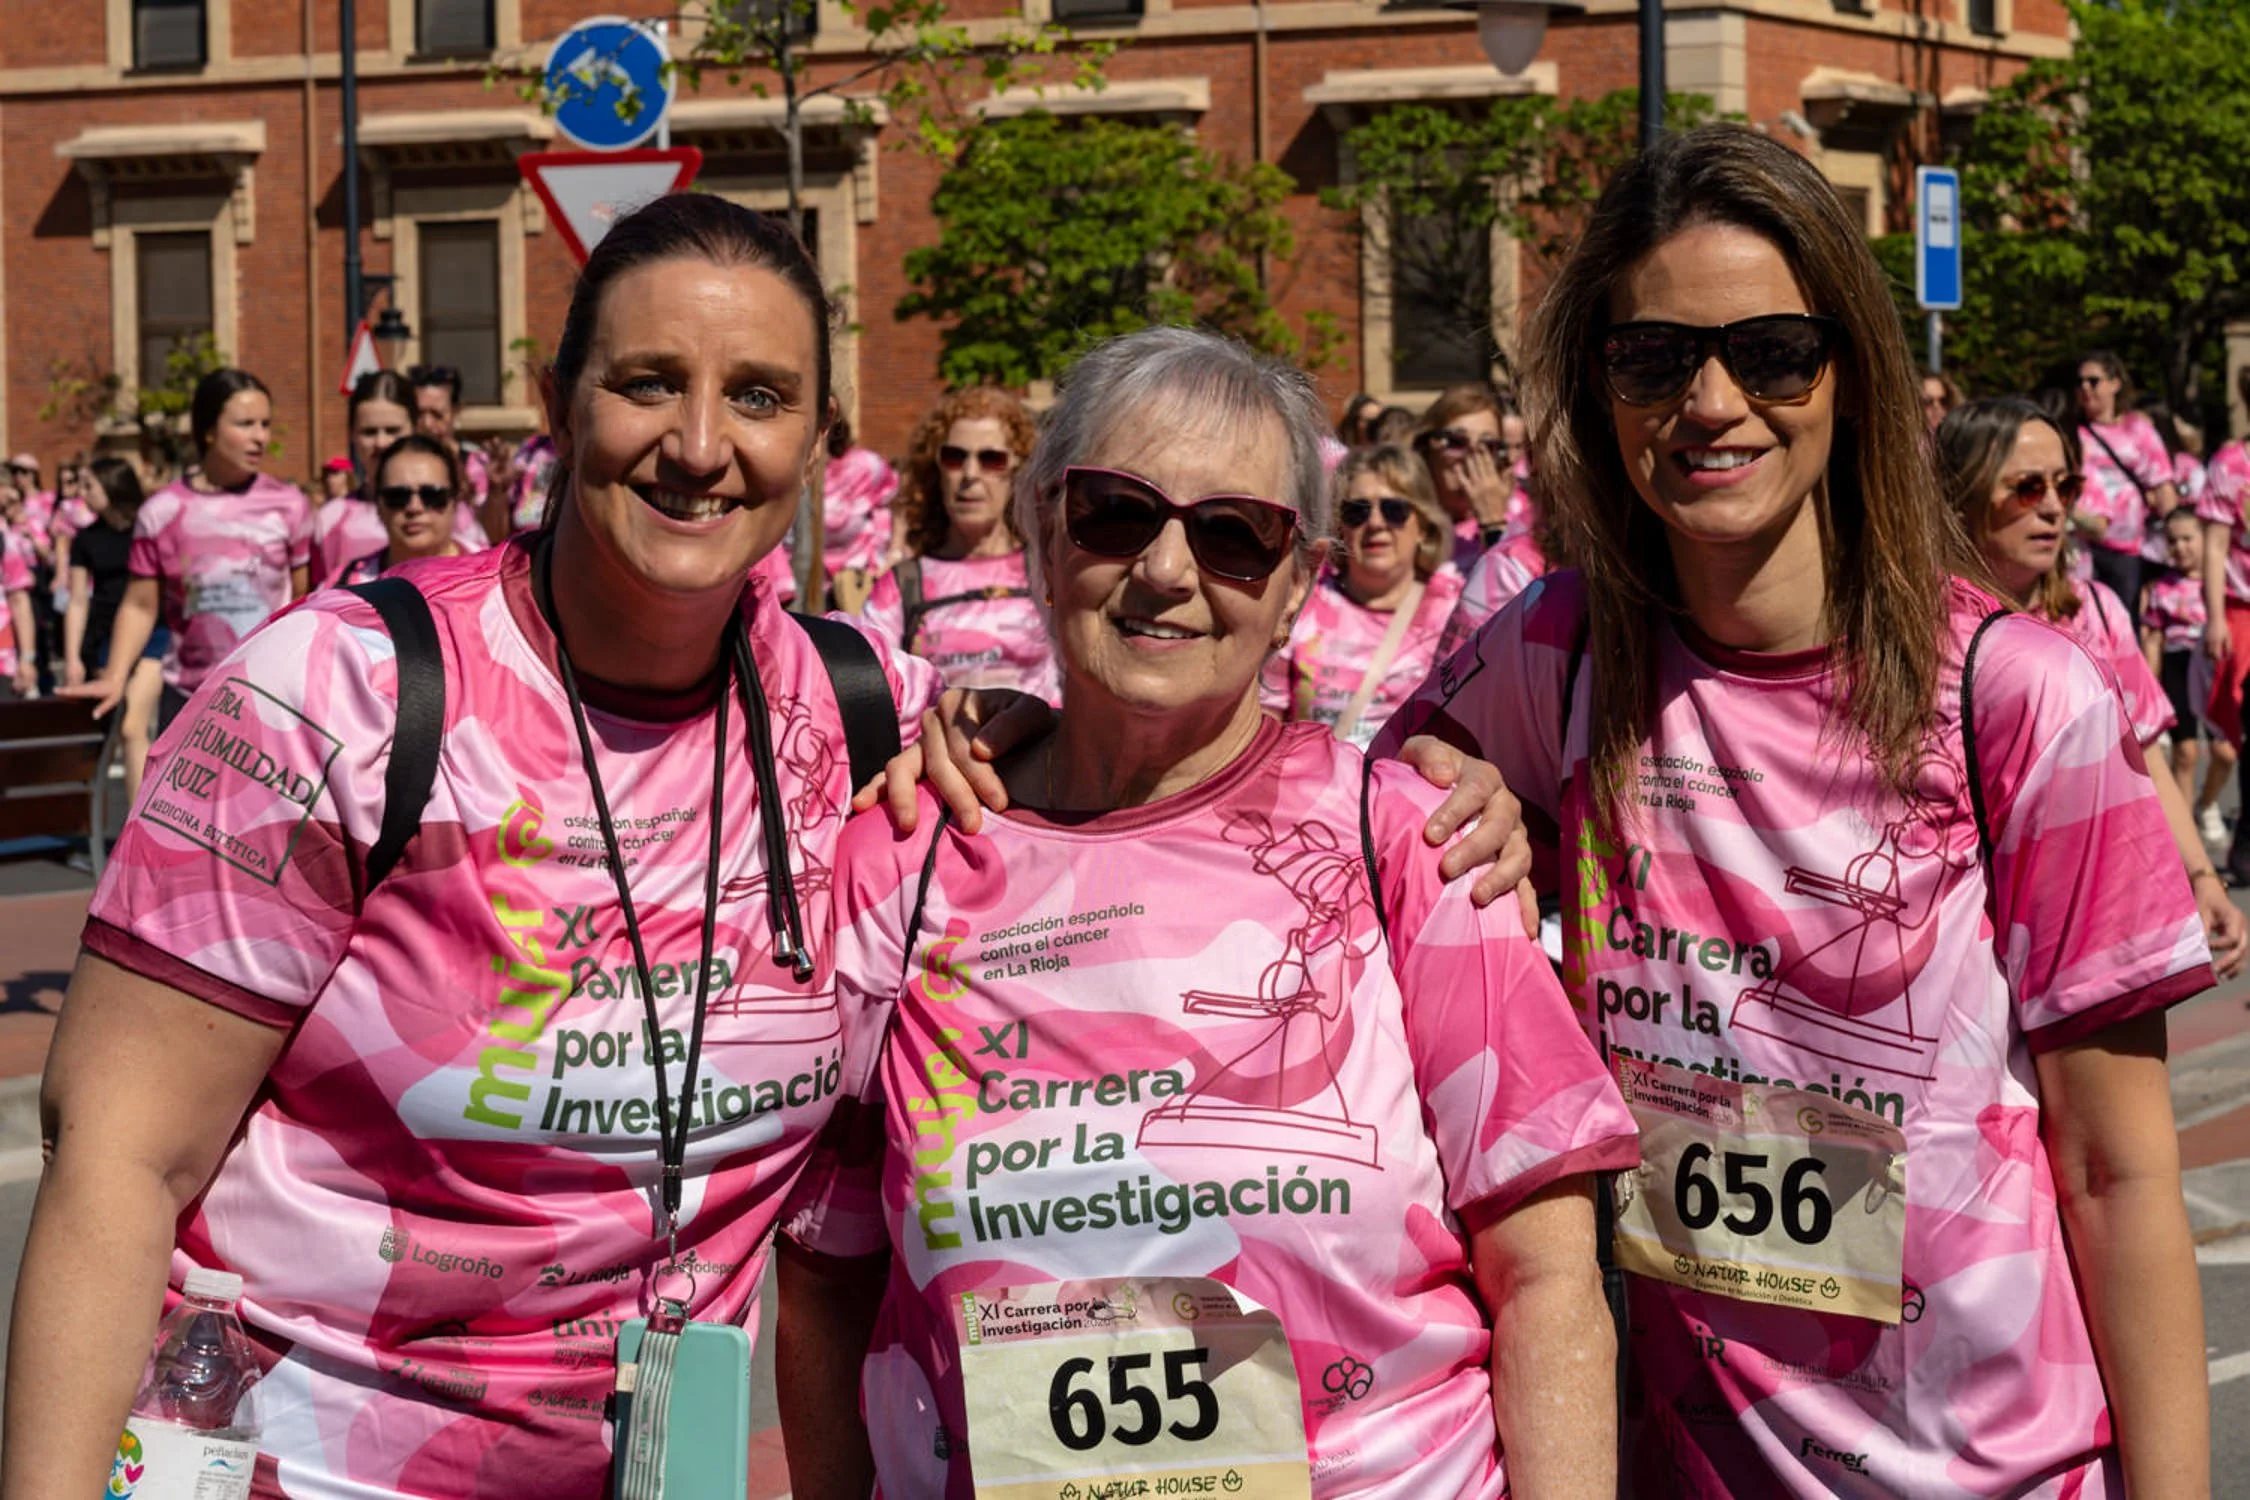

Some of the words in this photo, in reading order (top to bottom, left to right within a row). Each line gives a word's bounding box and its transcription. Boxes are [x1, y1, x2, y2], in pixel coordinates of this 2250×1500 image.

[209, 685, 245, 721] DRA
[167, 756, 218, 799] RUIZ
[184, 717, 316, 806] HUMILDAD
[1650, 792, 1664, 807] La
[1665, 793, 1697, 814] Rioja
[1673, 775, 1685, 789] el
[1687, 777, 1740, 800] cáncer
[150, 798, 201, 833] MEDICINA
[203, 823, 268, 869] ESTÉTICA
[622, 830, 676, 850] cáncer
[577, 854, 595, 868] La
[979, 918, 1065, 944] asociación
[1068, 903, 1145, 927] española
[1606, 904, 1775, 981] Carrera
[979, 944, 1032, 963] contra
[1035, 936, 1050, 951] el
[1054, 927, 1110, 947] cáncer
[983, 966, 1005, 981] en
[1007, 962, 1027, 978] La
[1030, 953, 1071, 975] Rioja
[1597, 976, 1672, 1026] por
[1680, 983, 1722, 1038] la
[552, 1027, 633, 1081] por
[641, 1017, 687, 1066] la
[974, 1019, 1030, 1060] XI
[539, 1047, 842, 1134] Investigació
[977, 1069, 1186, 1114] Carrera
[1631, 1069, 1649, 1089] XI
[1651, 1079, 1697, 1099] Carrera
[1697, 1090, 1720, 1105] por
[1633, 1088, 1710, 1119] Investigación
[907, 1027, 978, 1251] mujer
[966, 1136, 1062, 1190] por
[1072, 1123, 1125, 1165] la
[967, 1163, 1352, 1243] Investigación
[1674, 1142, 1833, 1246] 656
[411, 1244, 505, 1281] Logroño
[1693, 1262, 1750, 1286] NATUR
[1755, 1270, 1817, 1295] HOUSE
[962, 1294, 981, 1342] mujer
[979, 1303, 1000, 1321] XI
[1004, 1303, 1061, 1319] Carrera
[1064, 1301, 1091, 1316] por
[1049, 1347, 1220, 1451] 655
[1801, 1437, 1869, 1468] Ferrer
[1086, 1479, 1150, 1500] NATUR
[1154, 1475, 1218, 1495] HOUSE
